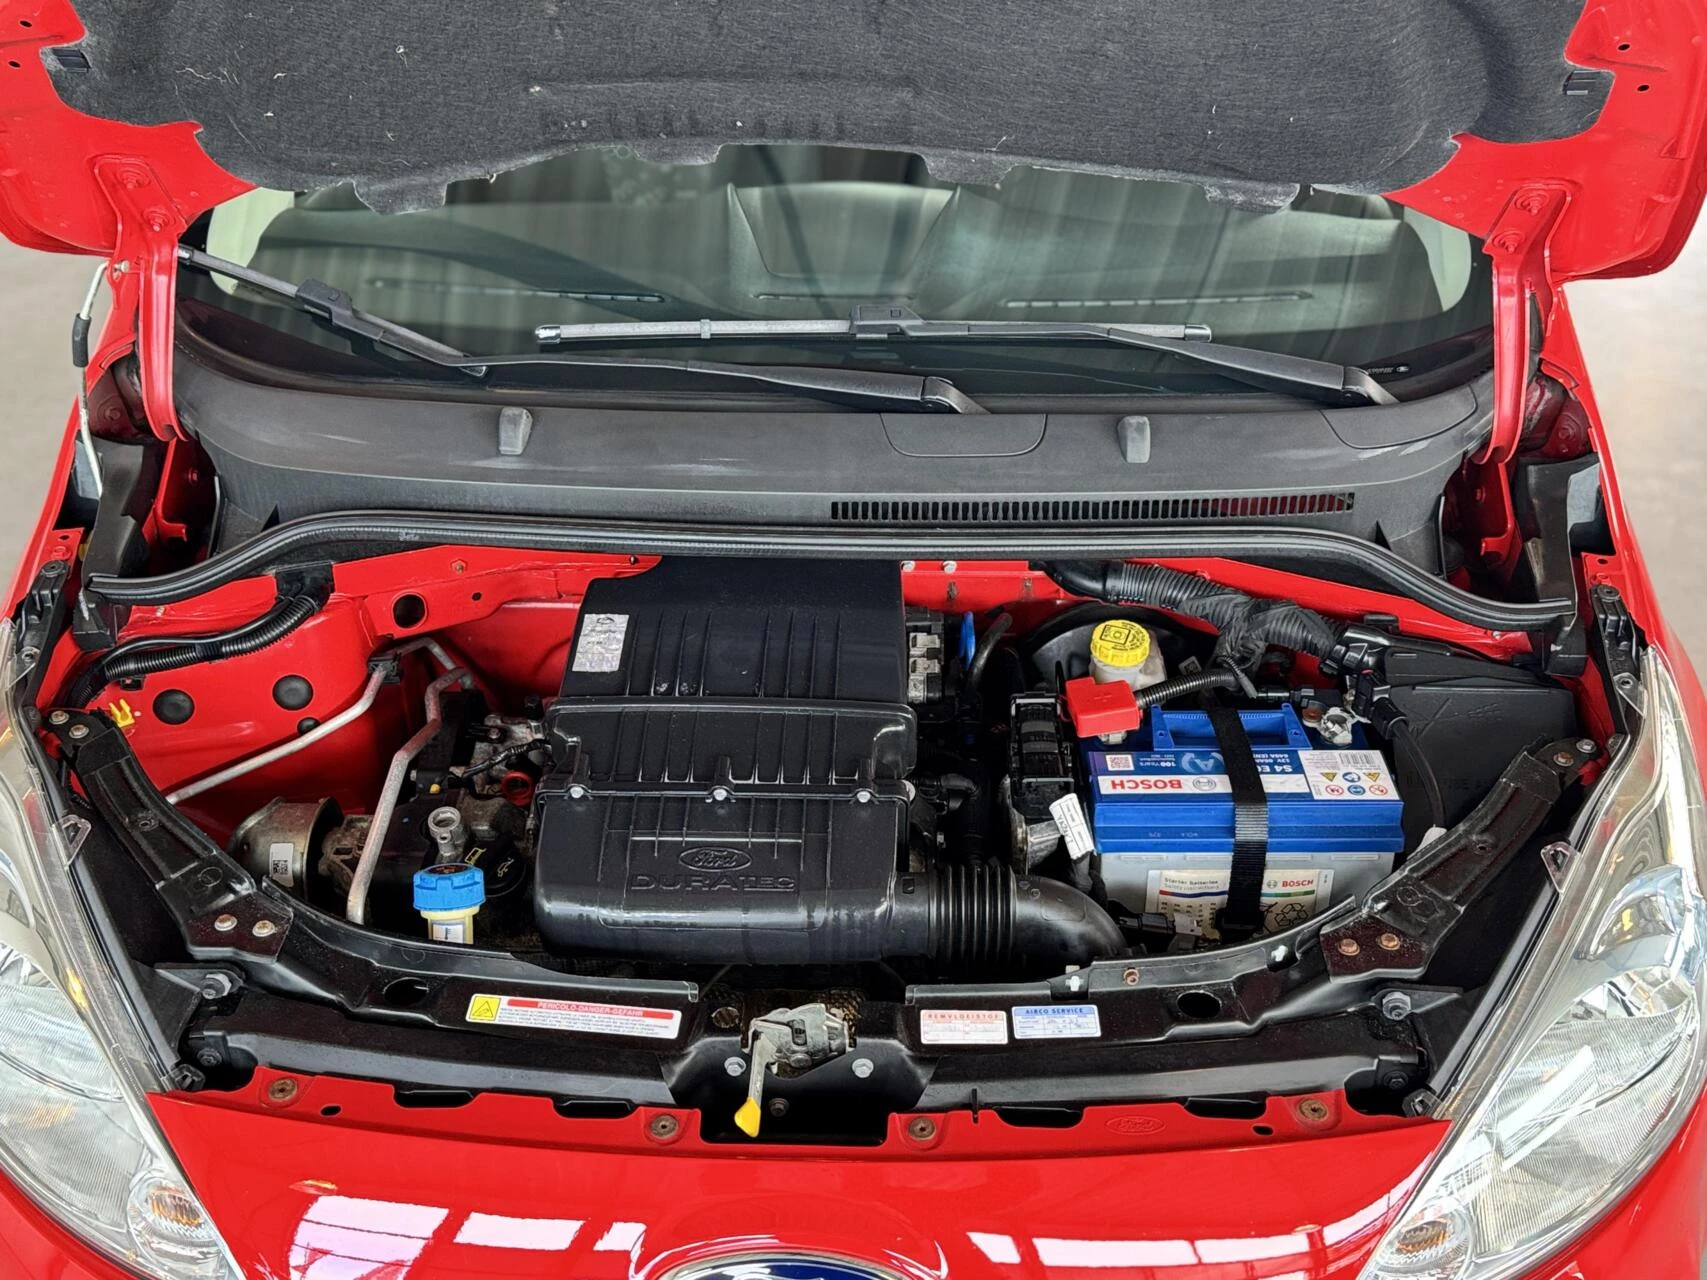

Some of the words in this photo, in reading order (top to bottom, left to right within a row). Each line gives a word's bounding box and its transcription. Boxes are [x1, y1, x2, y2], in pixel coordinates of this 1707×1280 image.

[1273, 765, 1293, 773] S4
[1110, 778, 1184, 790] BOSCH
[693, 850, 738, 868] Ford
[630, 874, 796, 892] DURATEC
[1281, 879, 1314, 888] BOSCH
[927, 1012, 999, 1020] REMVLOEISTOF
